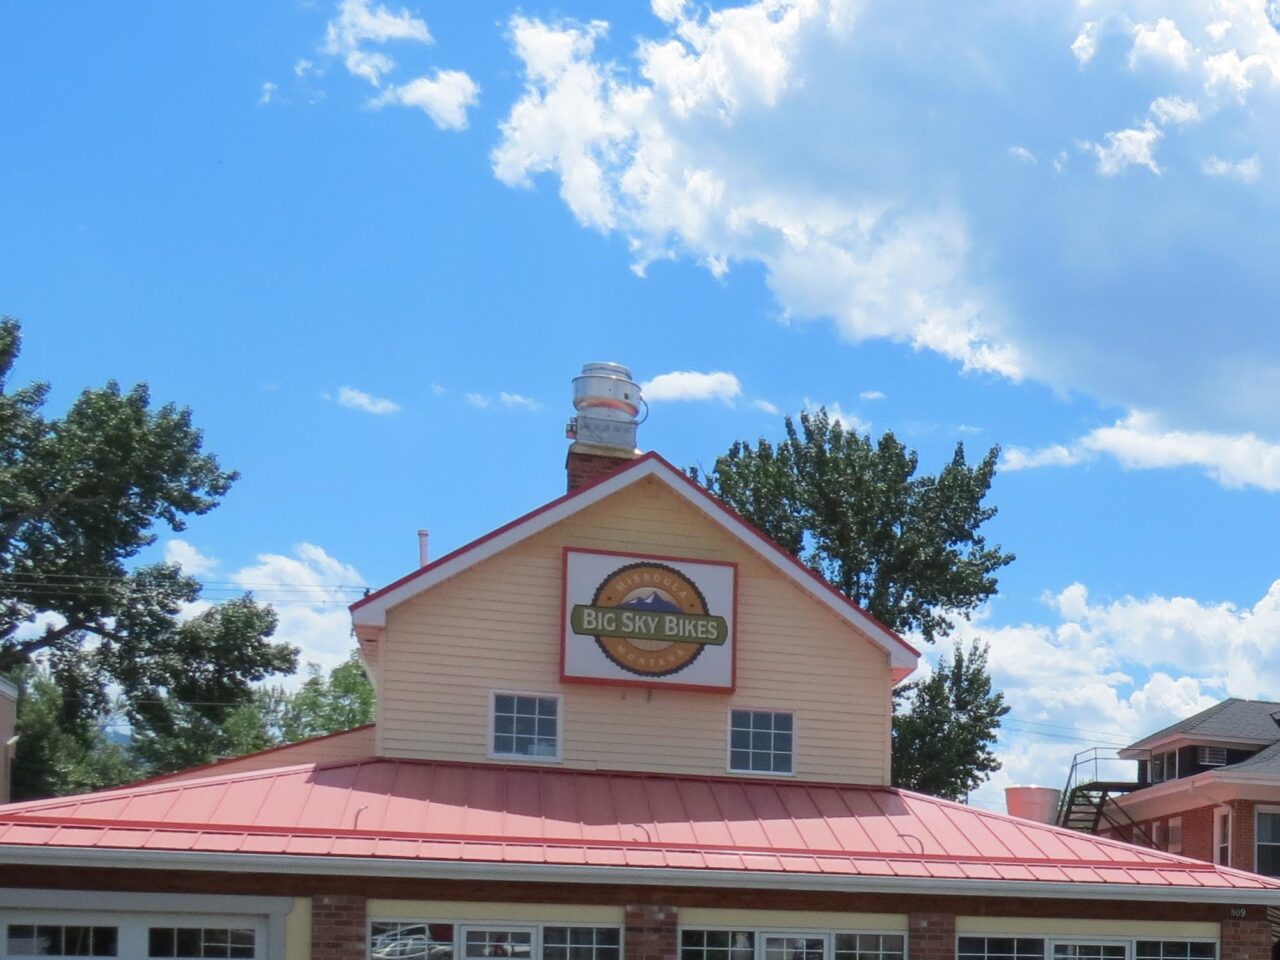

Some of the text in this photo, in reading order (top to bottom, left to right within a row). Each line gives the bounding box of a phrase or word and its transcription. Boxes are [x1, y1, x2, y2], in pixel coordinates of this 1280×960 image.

[616, 573, 688, 598] MISSOULA
[583, 609, 718, 639] BIG SKY BIKES
[616, 645, 685, 666] MONTANA
